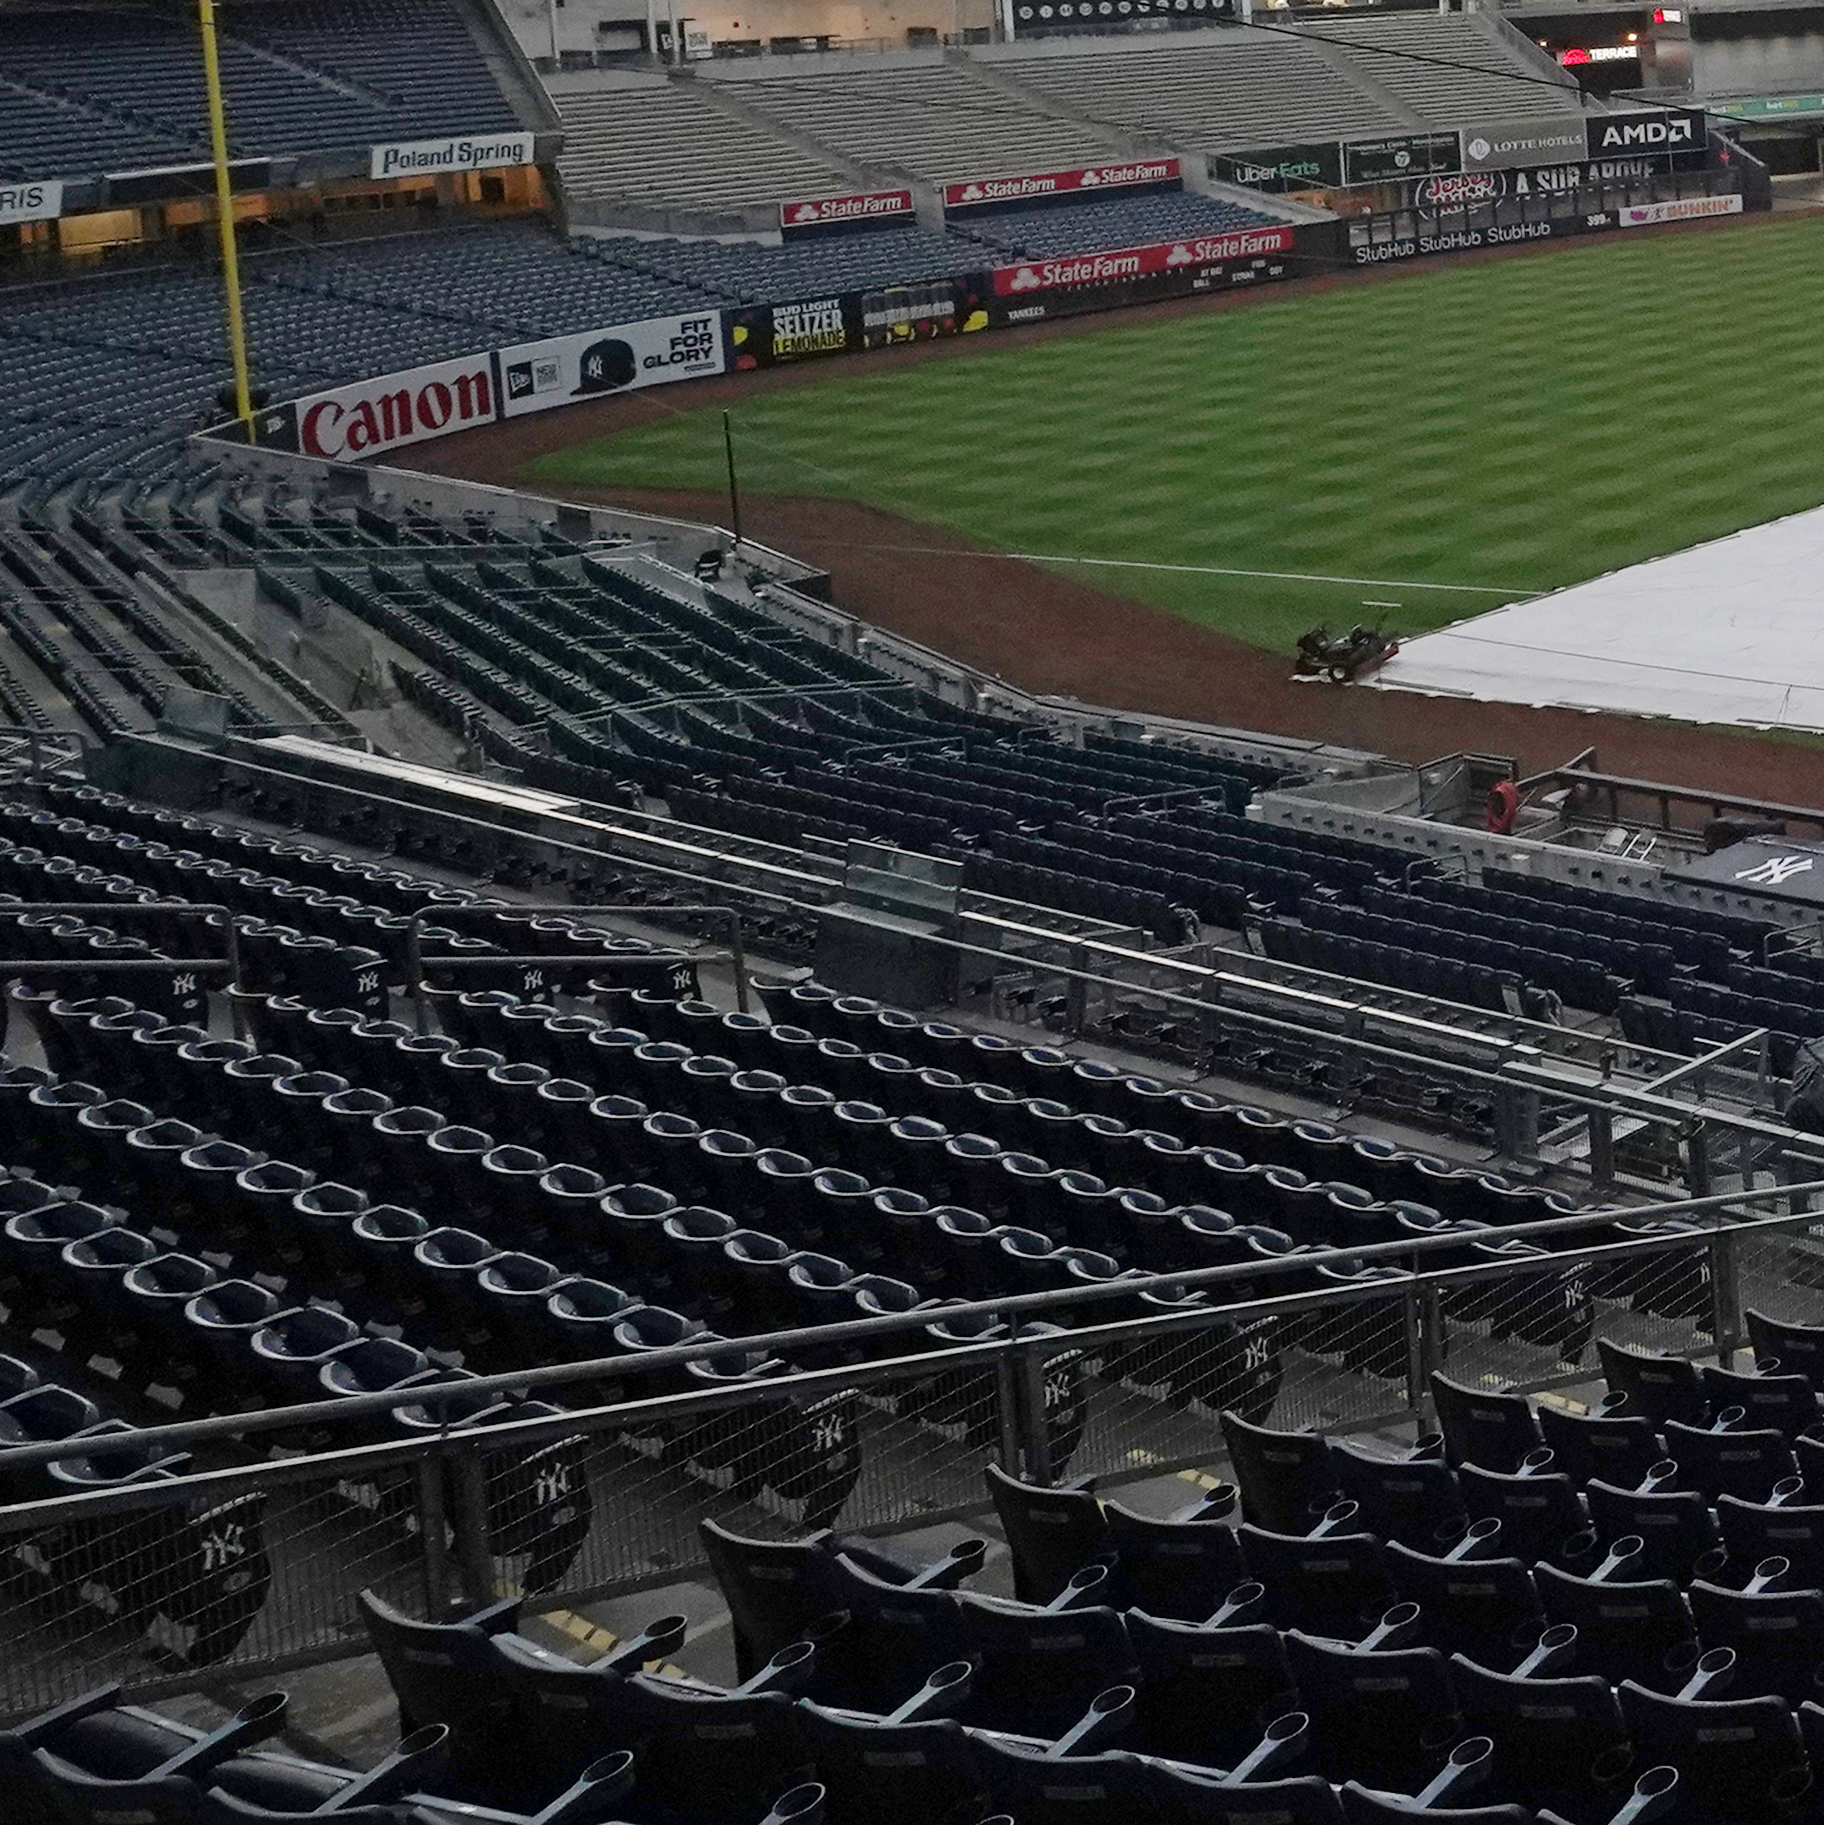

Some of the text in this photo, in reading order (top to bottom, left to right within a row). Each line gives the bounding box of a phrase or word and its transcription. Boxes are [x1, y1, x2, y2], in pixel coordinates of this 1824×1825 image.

[1589, 45, 1638, 61] TERRACE
[1493, 134, 1583, 153] LOTTE HOTELS
[1602, 122, 1667, 147] AMD
[383, 139, 525, 174] Poland Spring
[1236, 160, 1321, 184] Uber Eats
[1667, 199, 1735, 218] DUNKIN'
[1355, 221, 1551, 264] StubHub StubHub StubHub
[772, 298, 841, 318] BUD LIGHT
[680, 318, 712, 334] FIT
[772, 309, 843, 340] SELTZER
[670, 332, 713, 351] FOR
[772, 330, 846, 356] LEMONADE
[642, 345, 713, 370] GLORY
[300, 368, 493, 458] Canon
